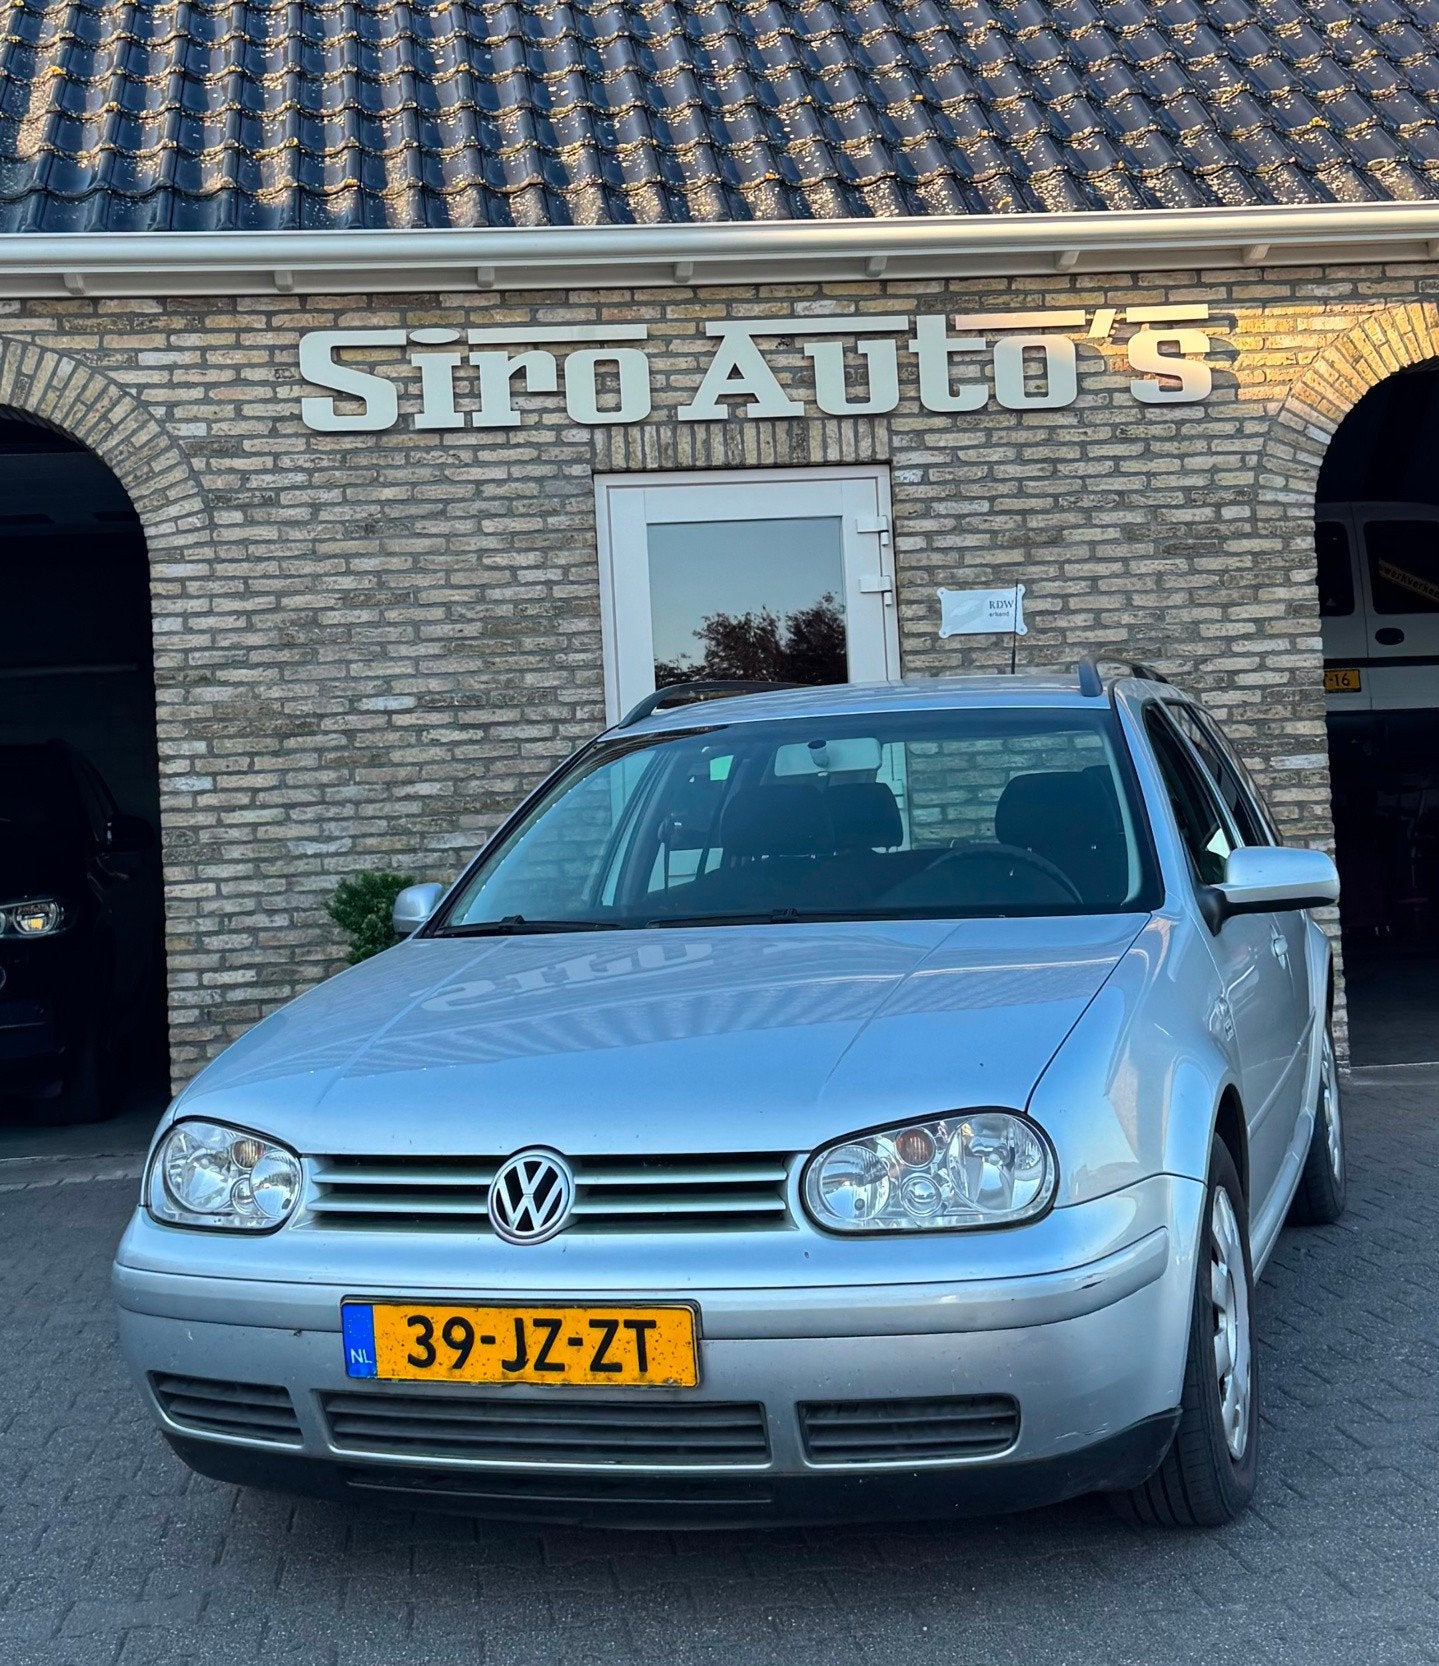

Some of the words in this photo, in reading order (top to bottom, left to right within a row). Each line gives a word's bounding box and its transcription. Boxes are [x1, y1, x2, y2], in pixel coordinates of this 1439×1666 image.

[299, 324, 652, 432] Siro
[677, 303, 1213, 422] Auto's
[989, 600, 1014, 609] RDW
[1323, 673, 1350, 687] -16
[492, 1153, 568, 1238] VW
[350, 1348, 373, 1365] NL
[406, 1314, 657, 1374] 39-JZ-ZT
